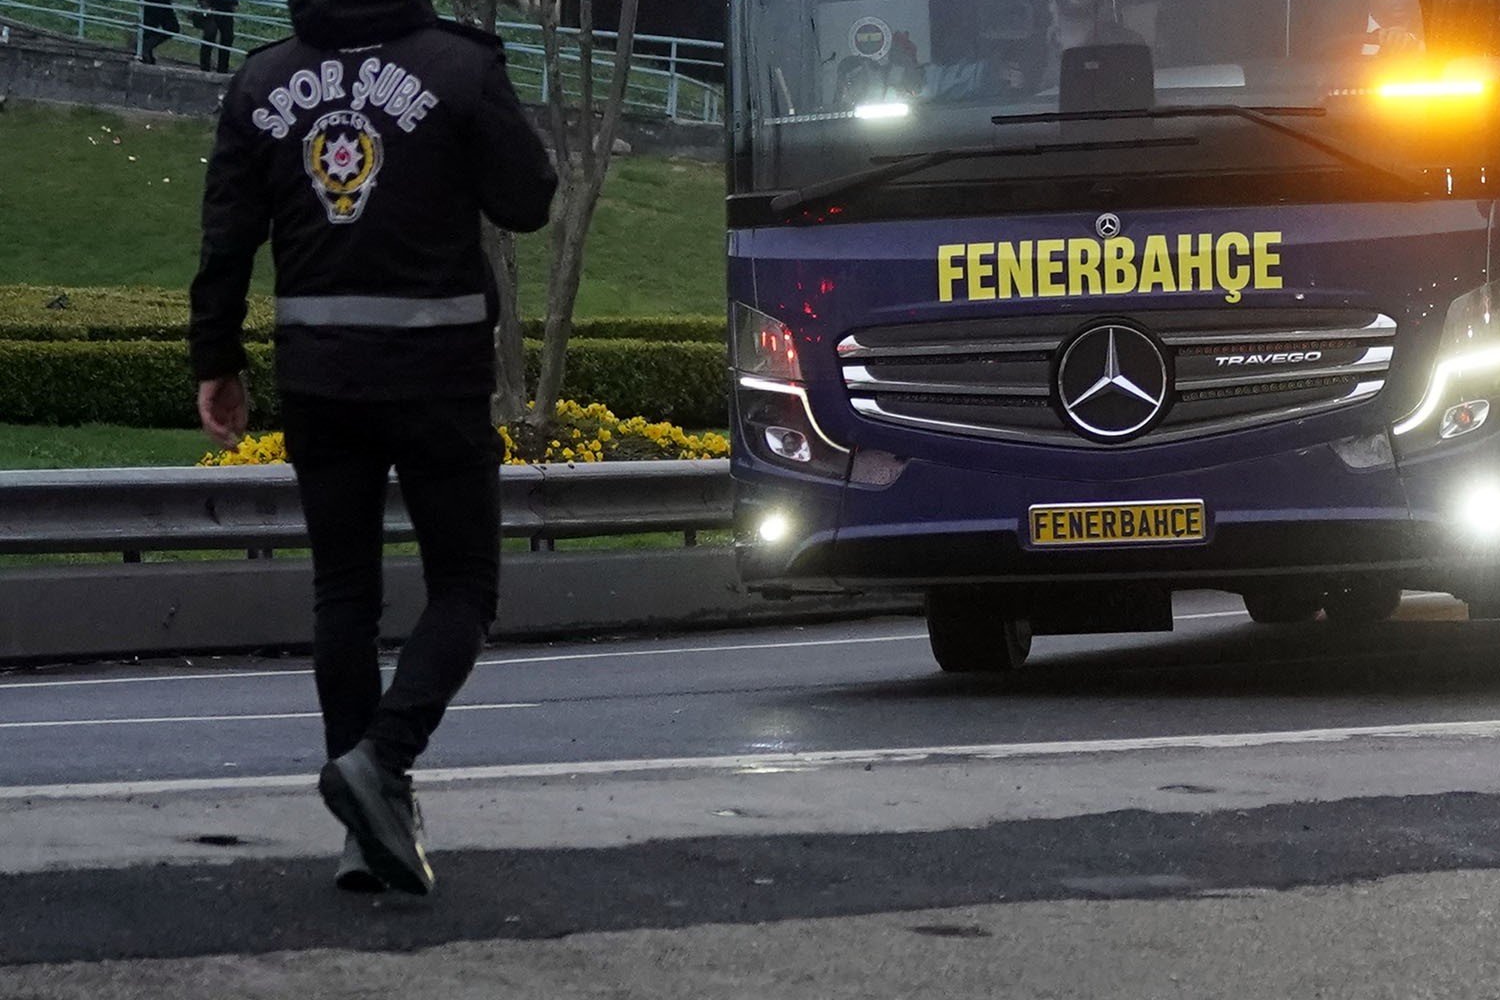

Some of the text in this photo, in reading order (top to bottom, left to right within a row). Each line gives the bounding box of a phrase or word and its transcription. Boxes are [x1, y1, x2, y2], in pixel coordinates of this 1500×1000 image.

[252, 57, 439, 139] SPOR ŞUBE
[938, 231, 1283, 304] FENERBAHÇE
[1216, 351, 1322, 367] TRAVEGO
[1034, 508, 1200, 542] FENERBAHÇE
